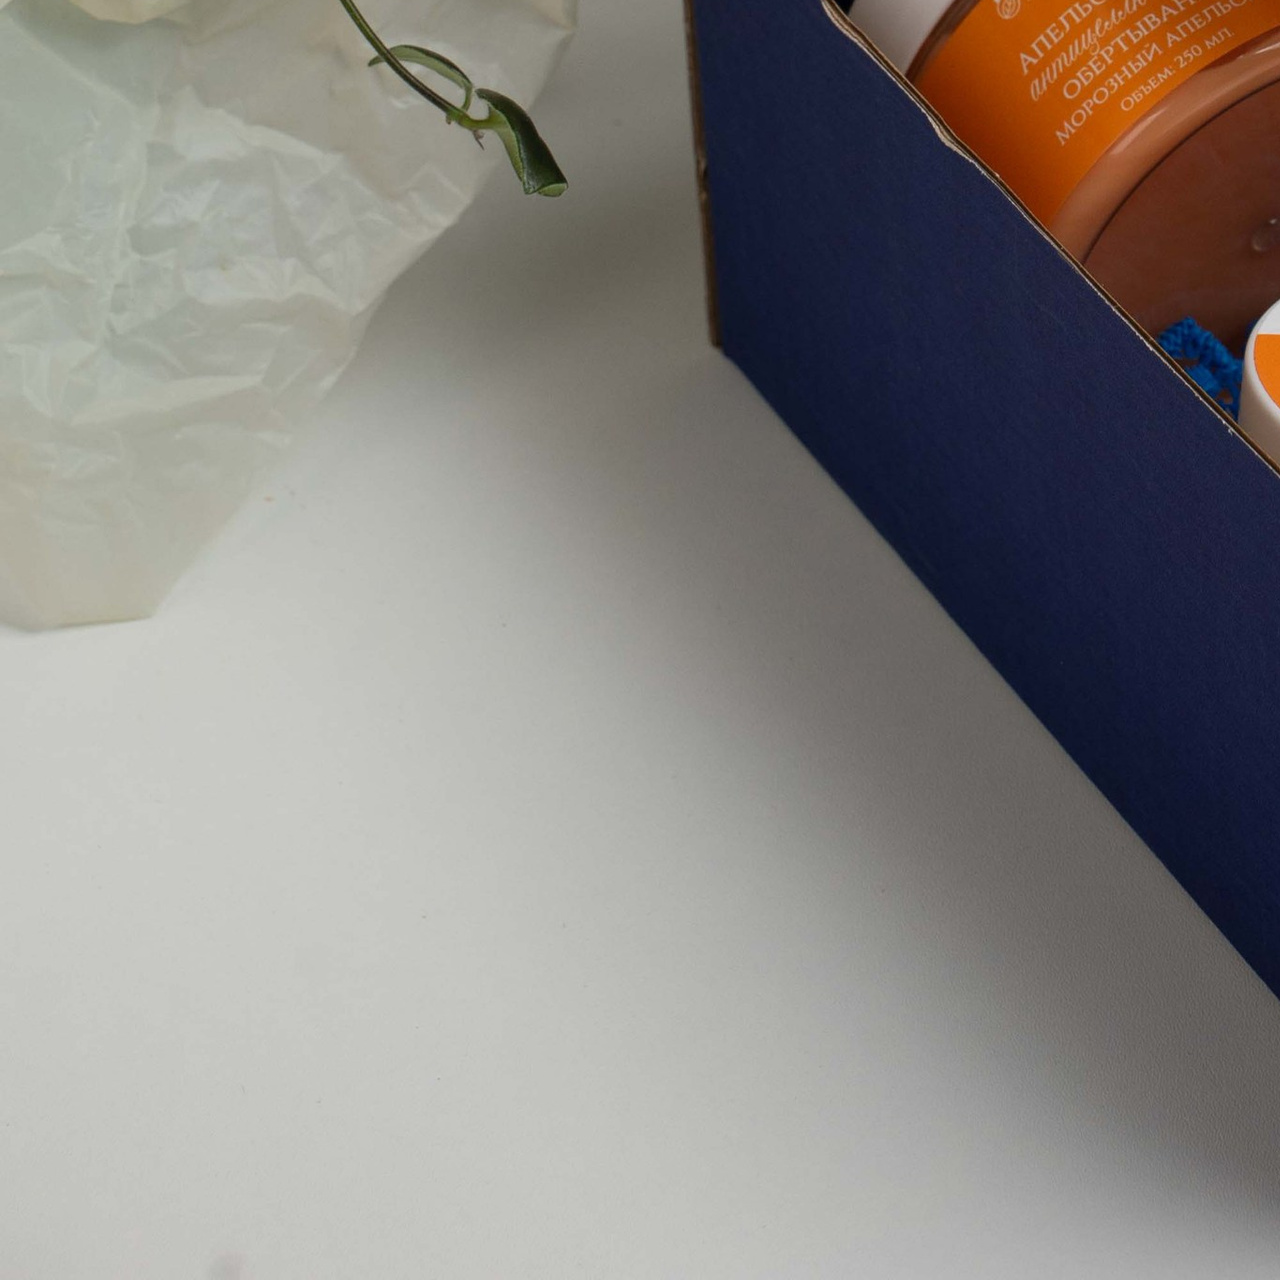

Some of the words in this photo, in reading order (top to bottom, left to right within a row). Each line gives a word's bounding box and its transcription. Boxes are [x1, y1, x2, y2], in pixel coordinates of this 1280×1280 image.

[1055, 42, 1164, 145] МОРОЗНЫЙ
[1120, 63, 1176, 112] ОБЪЕМ:
[1177, 44, 1202, 69] 250
[1205, 28, 1235, 50] МЛ.
